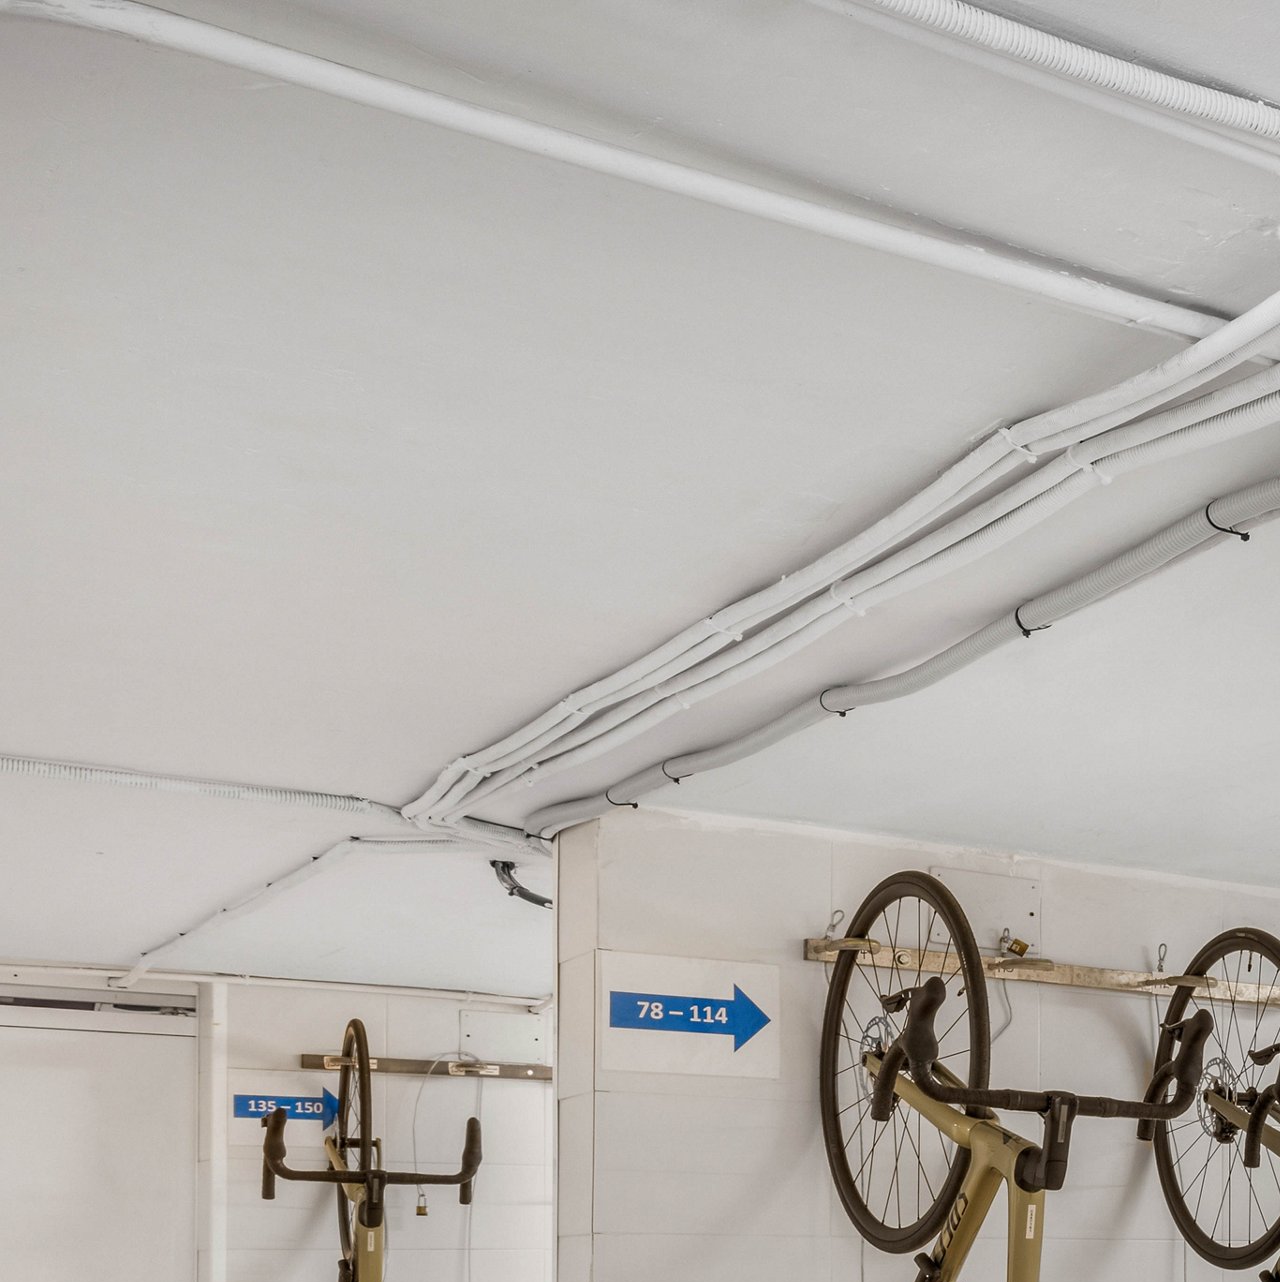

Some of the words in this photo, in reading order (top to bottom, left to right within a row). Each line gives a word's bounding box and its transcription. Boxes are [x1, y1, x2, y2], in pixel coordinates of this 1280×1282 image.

[637, 1001, 664, 1020] 78
[689, 1005, 729, 1024] 114
[247, 1100, 277, 1112] 135
[295, 1102, 324, 1113] 150
